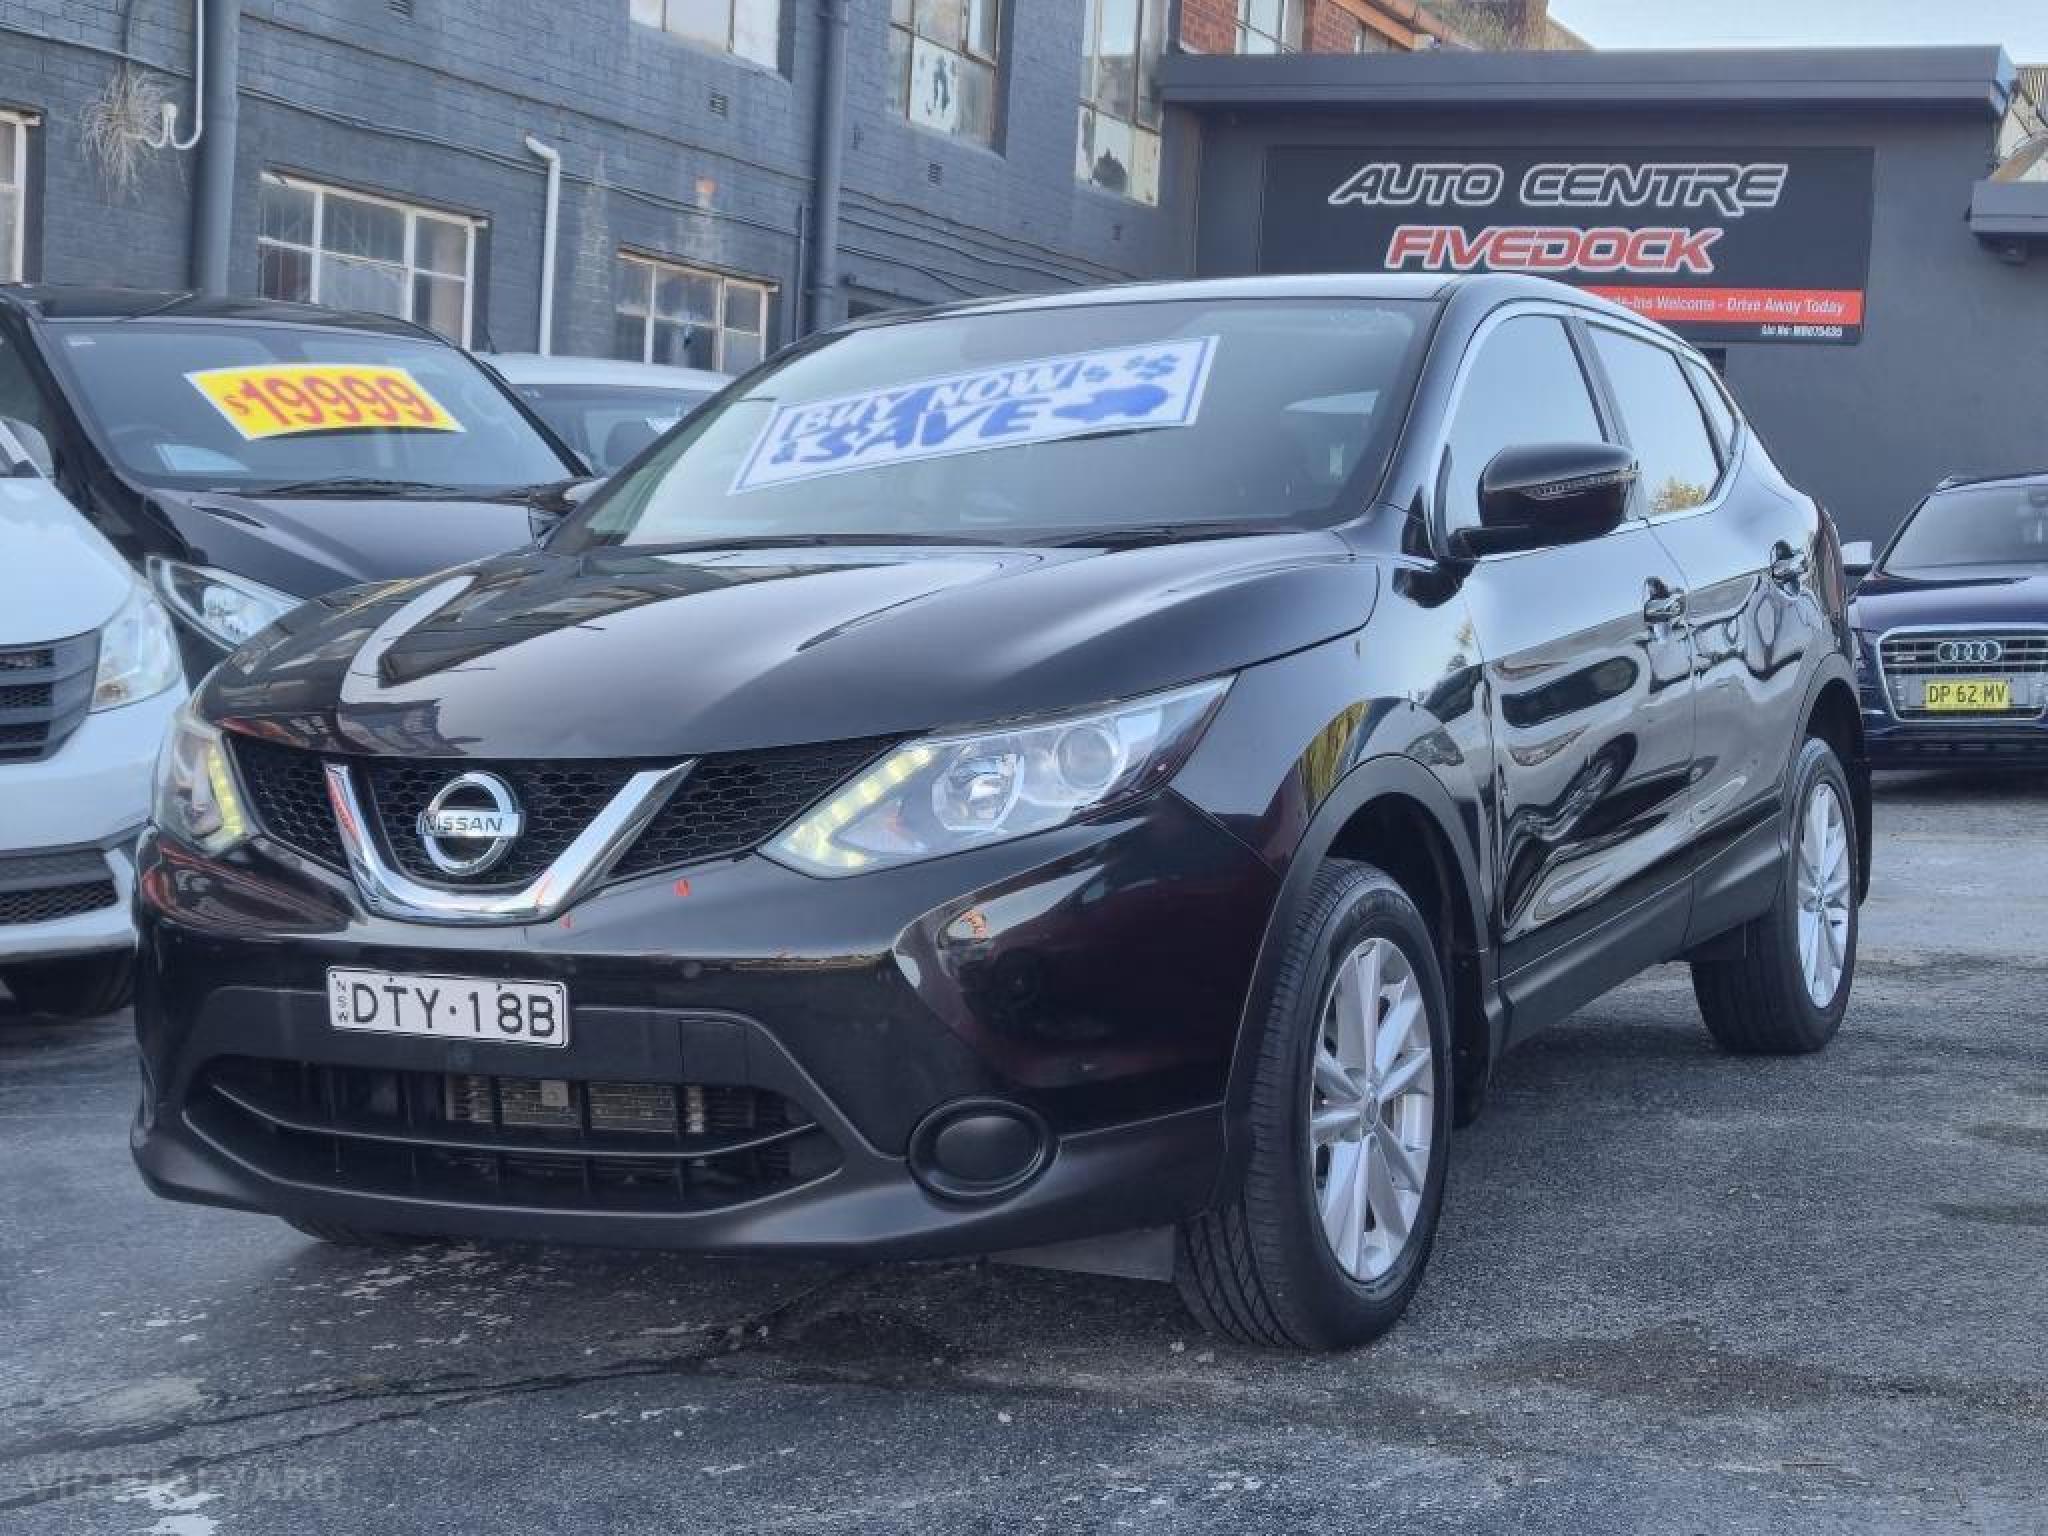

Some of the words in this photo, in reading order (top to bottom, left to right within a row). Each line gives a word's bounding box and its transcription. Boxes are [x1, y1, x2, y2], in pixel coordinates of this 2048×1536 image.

[1328, 163, 1504, 205] AUTO
[1519, 163, 1788, 217] CENTRE
[1385, 225, 1724, 273] FIVEDOCK
[1657, 296, 1713, 311] Welcome
[1727, 297, 1761, 312] Drive
[1765, 298, 1801, 314] Away
[1805, 299, 1844, 315] Today
[797, 390, 902, 439] BUY
[925, 363, 1083, 408] NOW
[799, 396, 1051, 463] SAVE
[419, 813, 503, 832] NISSAN
